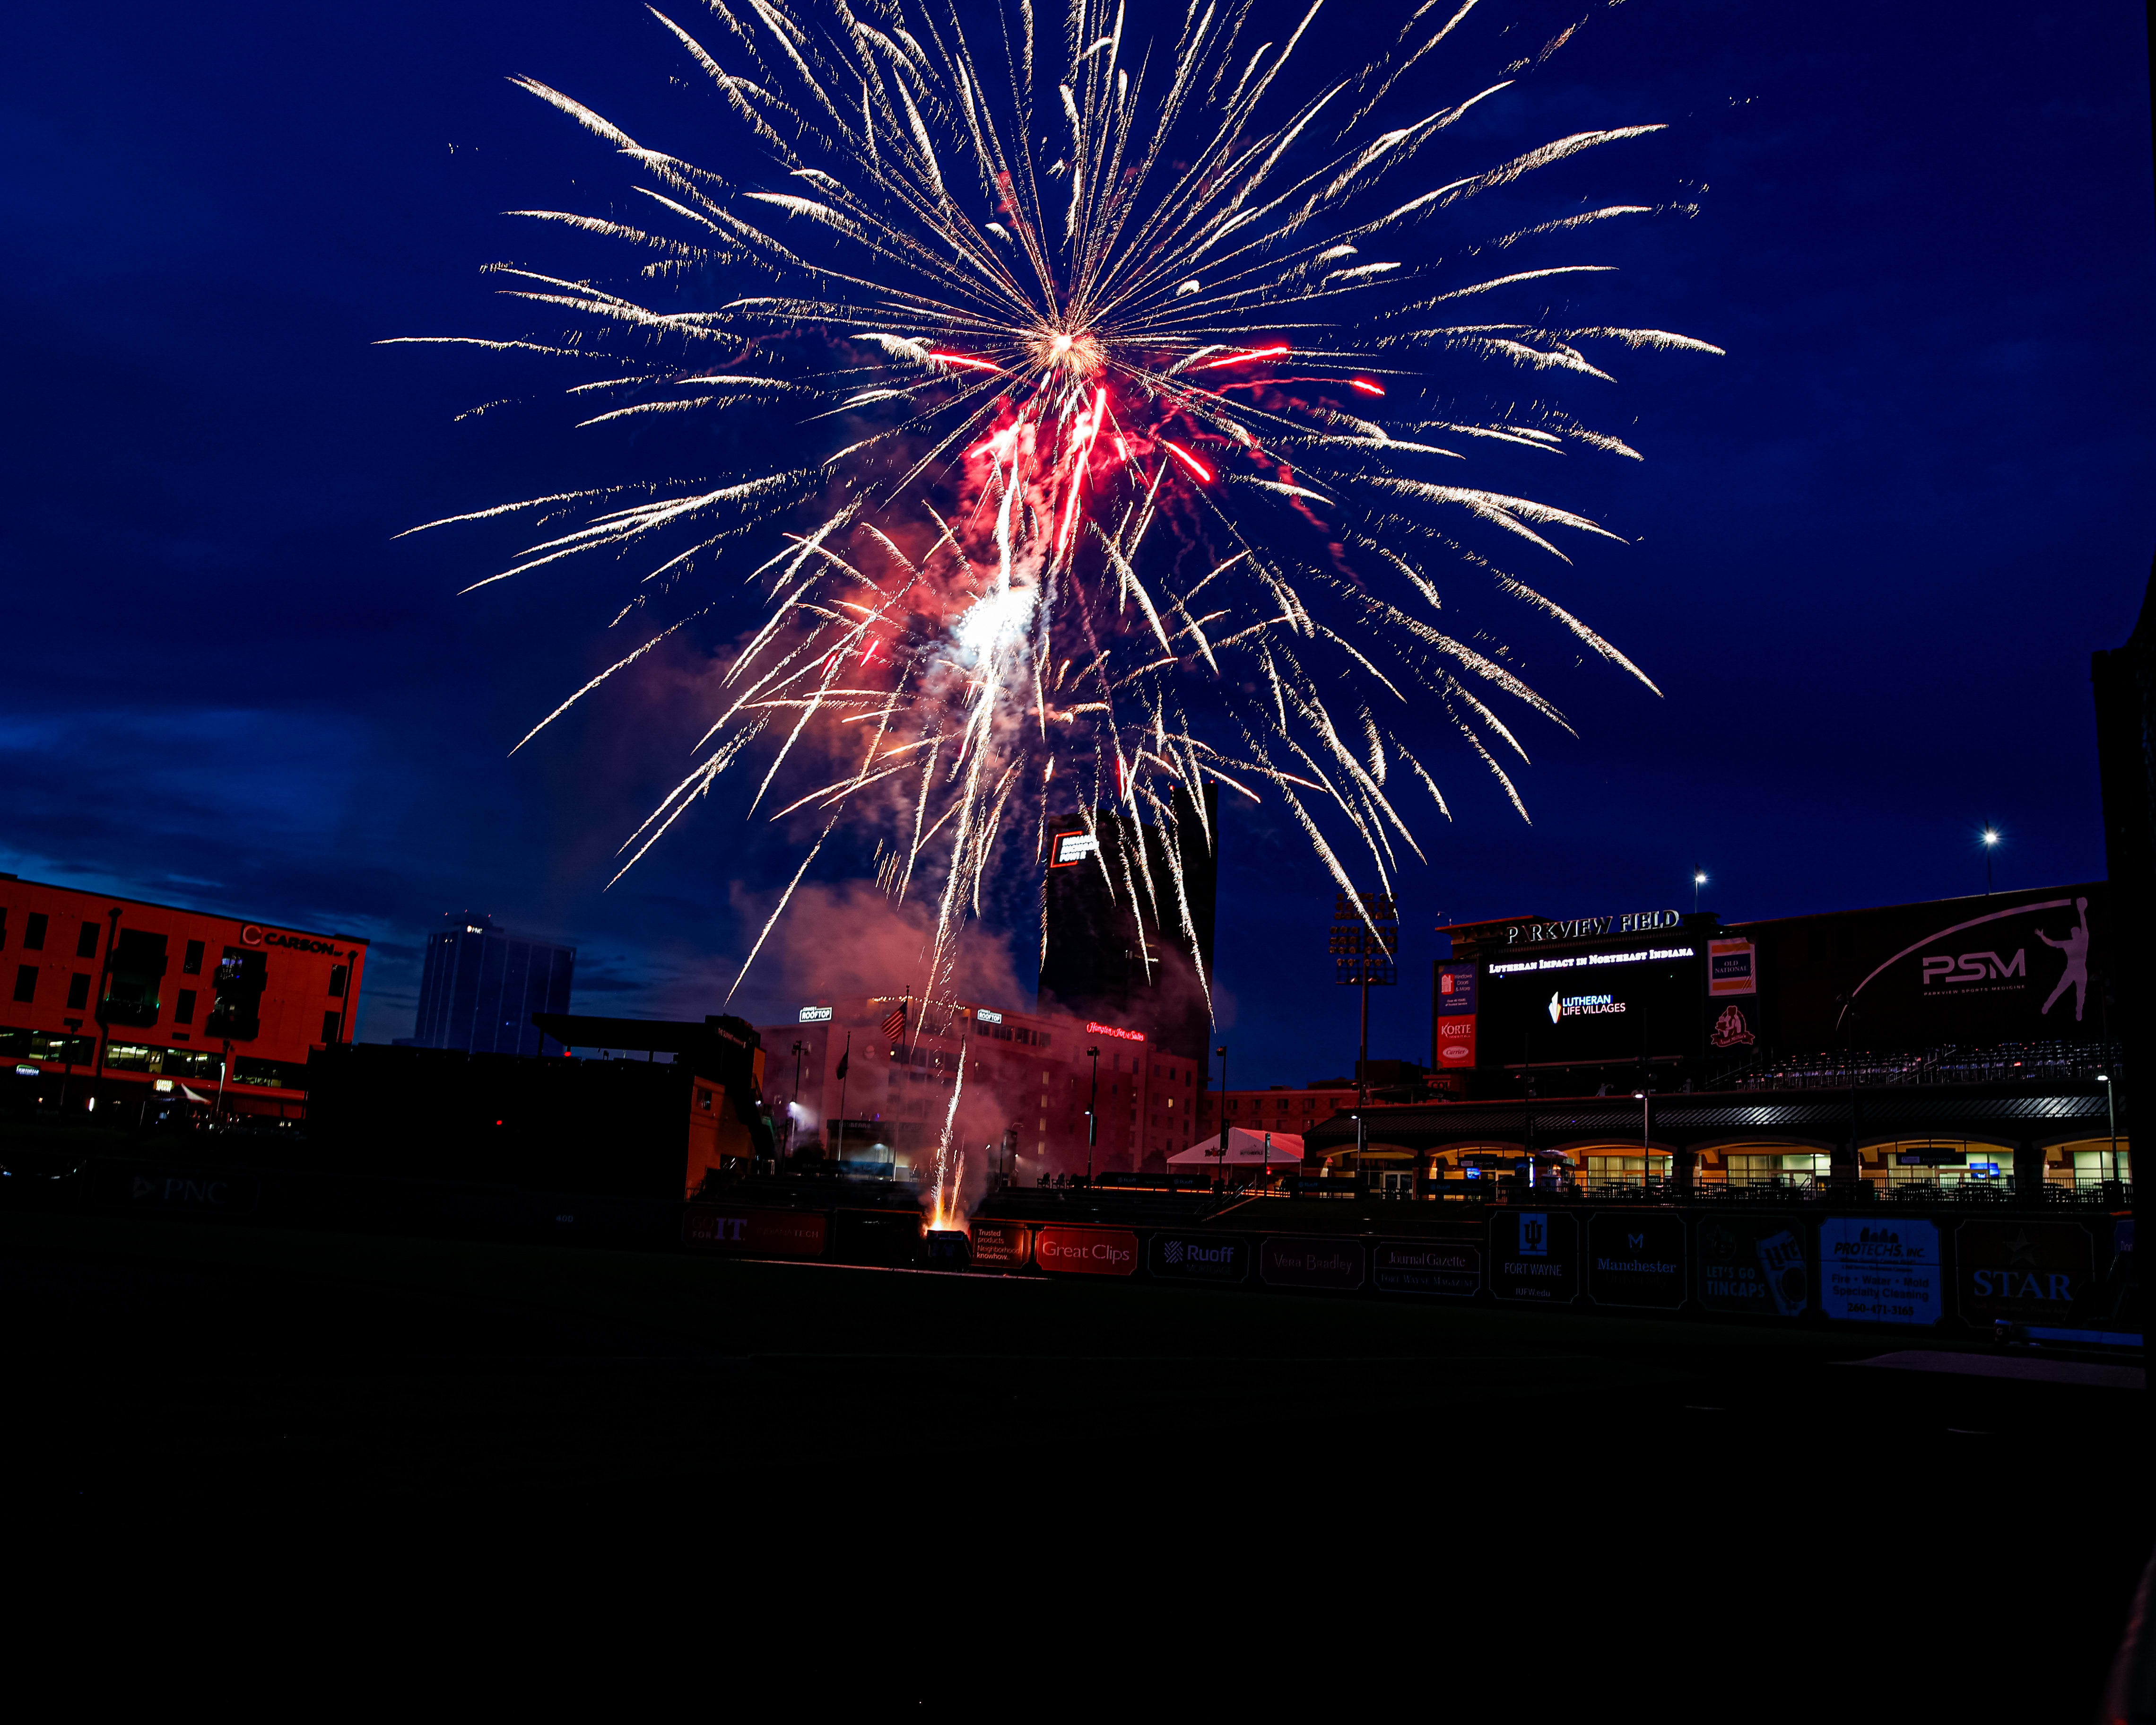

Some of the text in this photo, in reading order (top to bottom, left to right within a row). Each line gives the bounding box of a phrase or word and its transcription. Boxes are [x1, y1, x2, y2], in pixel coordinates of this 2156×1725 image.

[1619, 909, 1679, 933] FIELD
[264, 933, 335, 956] CARSON
[1489, 948, 1694, 974] LUTHERAN IMPACT IN NORTHEAST INDIANA
[1922, 948, 2026, 985] PSM
[1715, 965, 1748, 974] NATIONAL
[1563, 994, 1611, 1007] LUTHERAN
[801, 1010, 830, 1020] ROOFTOP
[979, 1012, 1000, 1022] ROOFTOP
[1563, 1002, 1626, 1016] LIFE VILLAGES
[1087, 1021, 1114, 1037] Hampton
[1113, 1028, 1127, 1039] Inn
[1131, 1031, 1144, 1042] Suites
[1441, 1022, 1471, 1038] KORTE
[164, 1178, 228, 1204] PNC
[556, 1214, 574, 1222] 400
[692, 1216, 713, 1229] GO
[692, 1230, 711, 1239] FOR
[793, 1229, 819, 1239] TECH
[977, 1245, 1020, 1254] Neighborhood
[1043, 1241, 1130, 1265] Great Clips
[1187, 1245, 1234, 1263] Ruoff
[1763, 1239, 1801, 1270] Lite
[1834, 1243, 1925, 1258] PROTECHS, INC.
[1306, 1253, 1353, 1275] Bradley
[1389, 1252, 1466, 1268] Journal Gazette
[1597, 1257, 1678, 1273] Manchester
[1186, 1264, 1233, 1275] MORTGAGE
[1504, 1262, 1562, 1277] FORT WAYNE
[1706, 1265, 1756, 1280] LET'S GO
[1381, 1272, 1475, 1288] FORT WAYNE MAGAZINE
[1604, 1269, 1668, 1290] University
[1832, 1274, 1929, 1288] Fire Water Mold
[1973, 1269, 2073, 1301] STAR
[1515, 1287, 1551, 1298] IUFW.edu
[1706, 1280, 1766, 1298] TINCAPS
[1833, 1286, 1929, 1302] Specialty Cleaning
[1848, 1303, 1914, 1316] 260-471-3165
